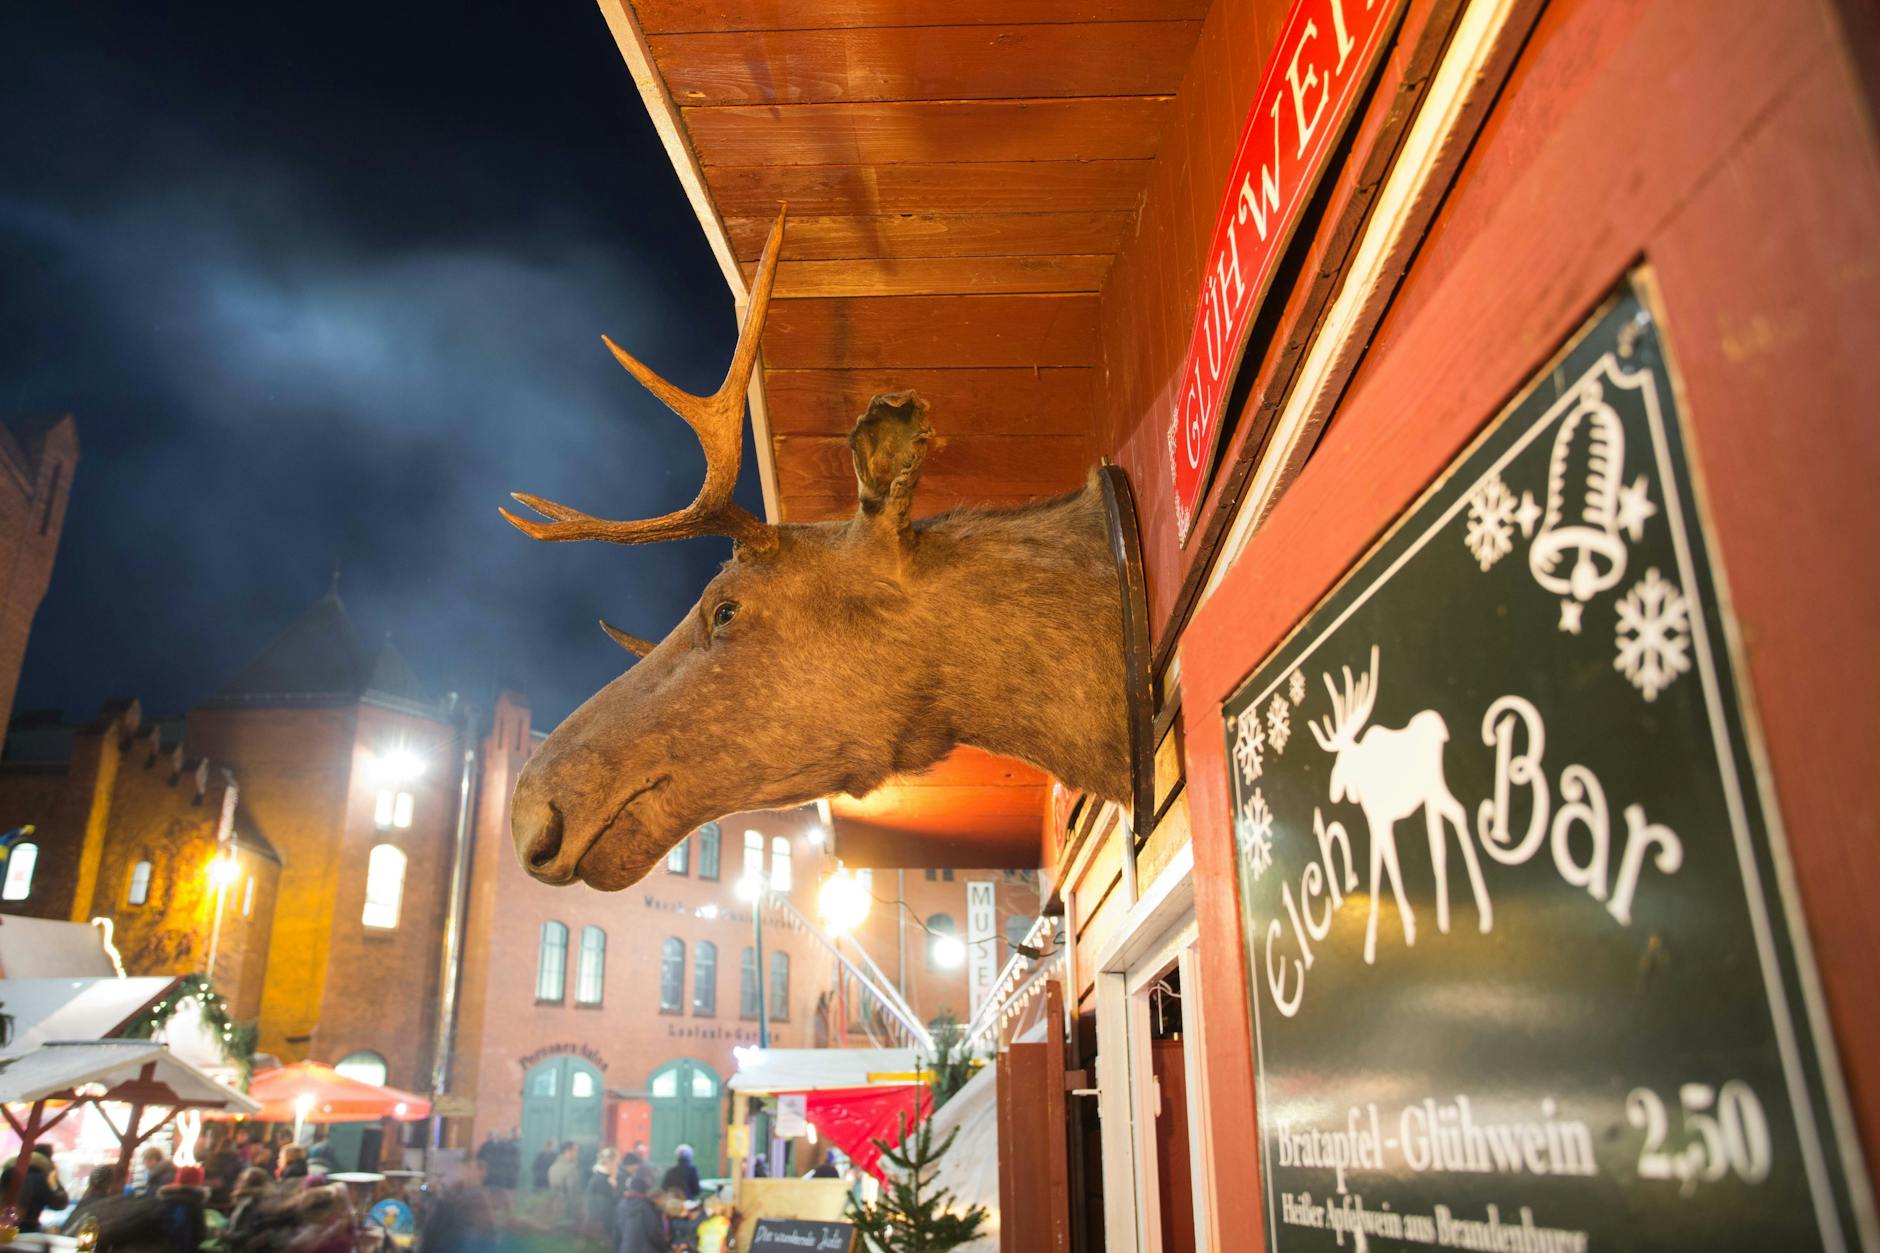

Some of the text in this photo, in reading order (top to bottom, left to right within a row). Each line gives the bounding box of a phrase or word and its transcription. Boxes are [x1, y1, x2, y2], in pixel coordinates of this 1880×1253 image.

[1186, 0, 1375, 470] GLÜHWEI
[1266, 695, 1683, 1018] Elch Bar
[971, 886, 991, 1004] MUSE
[1625, 1078, 1773, 1199] 2,50
[1403, 1214, 1437, 1245] aus
